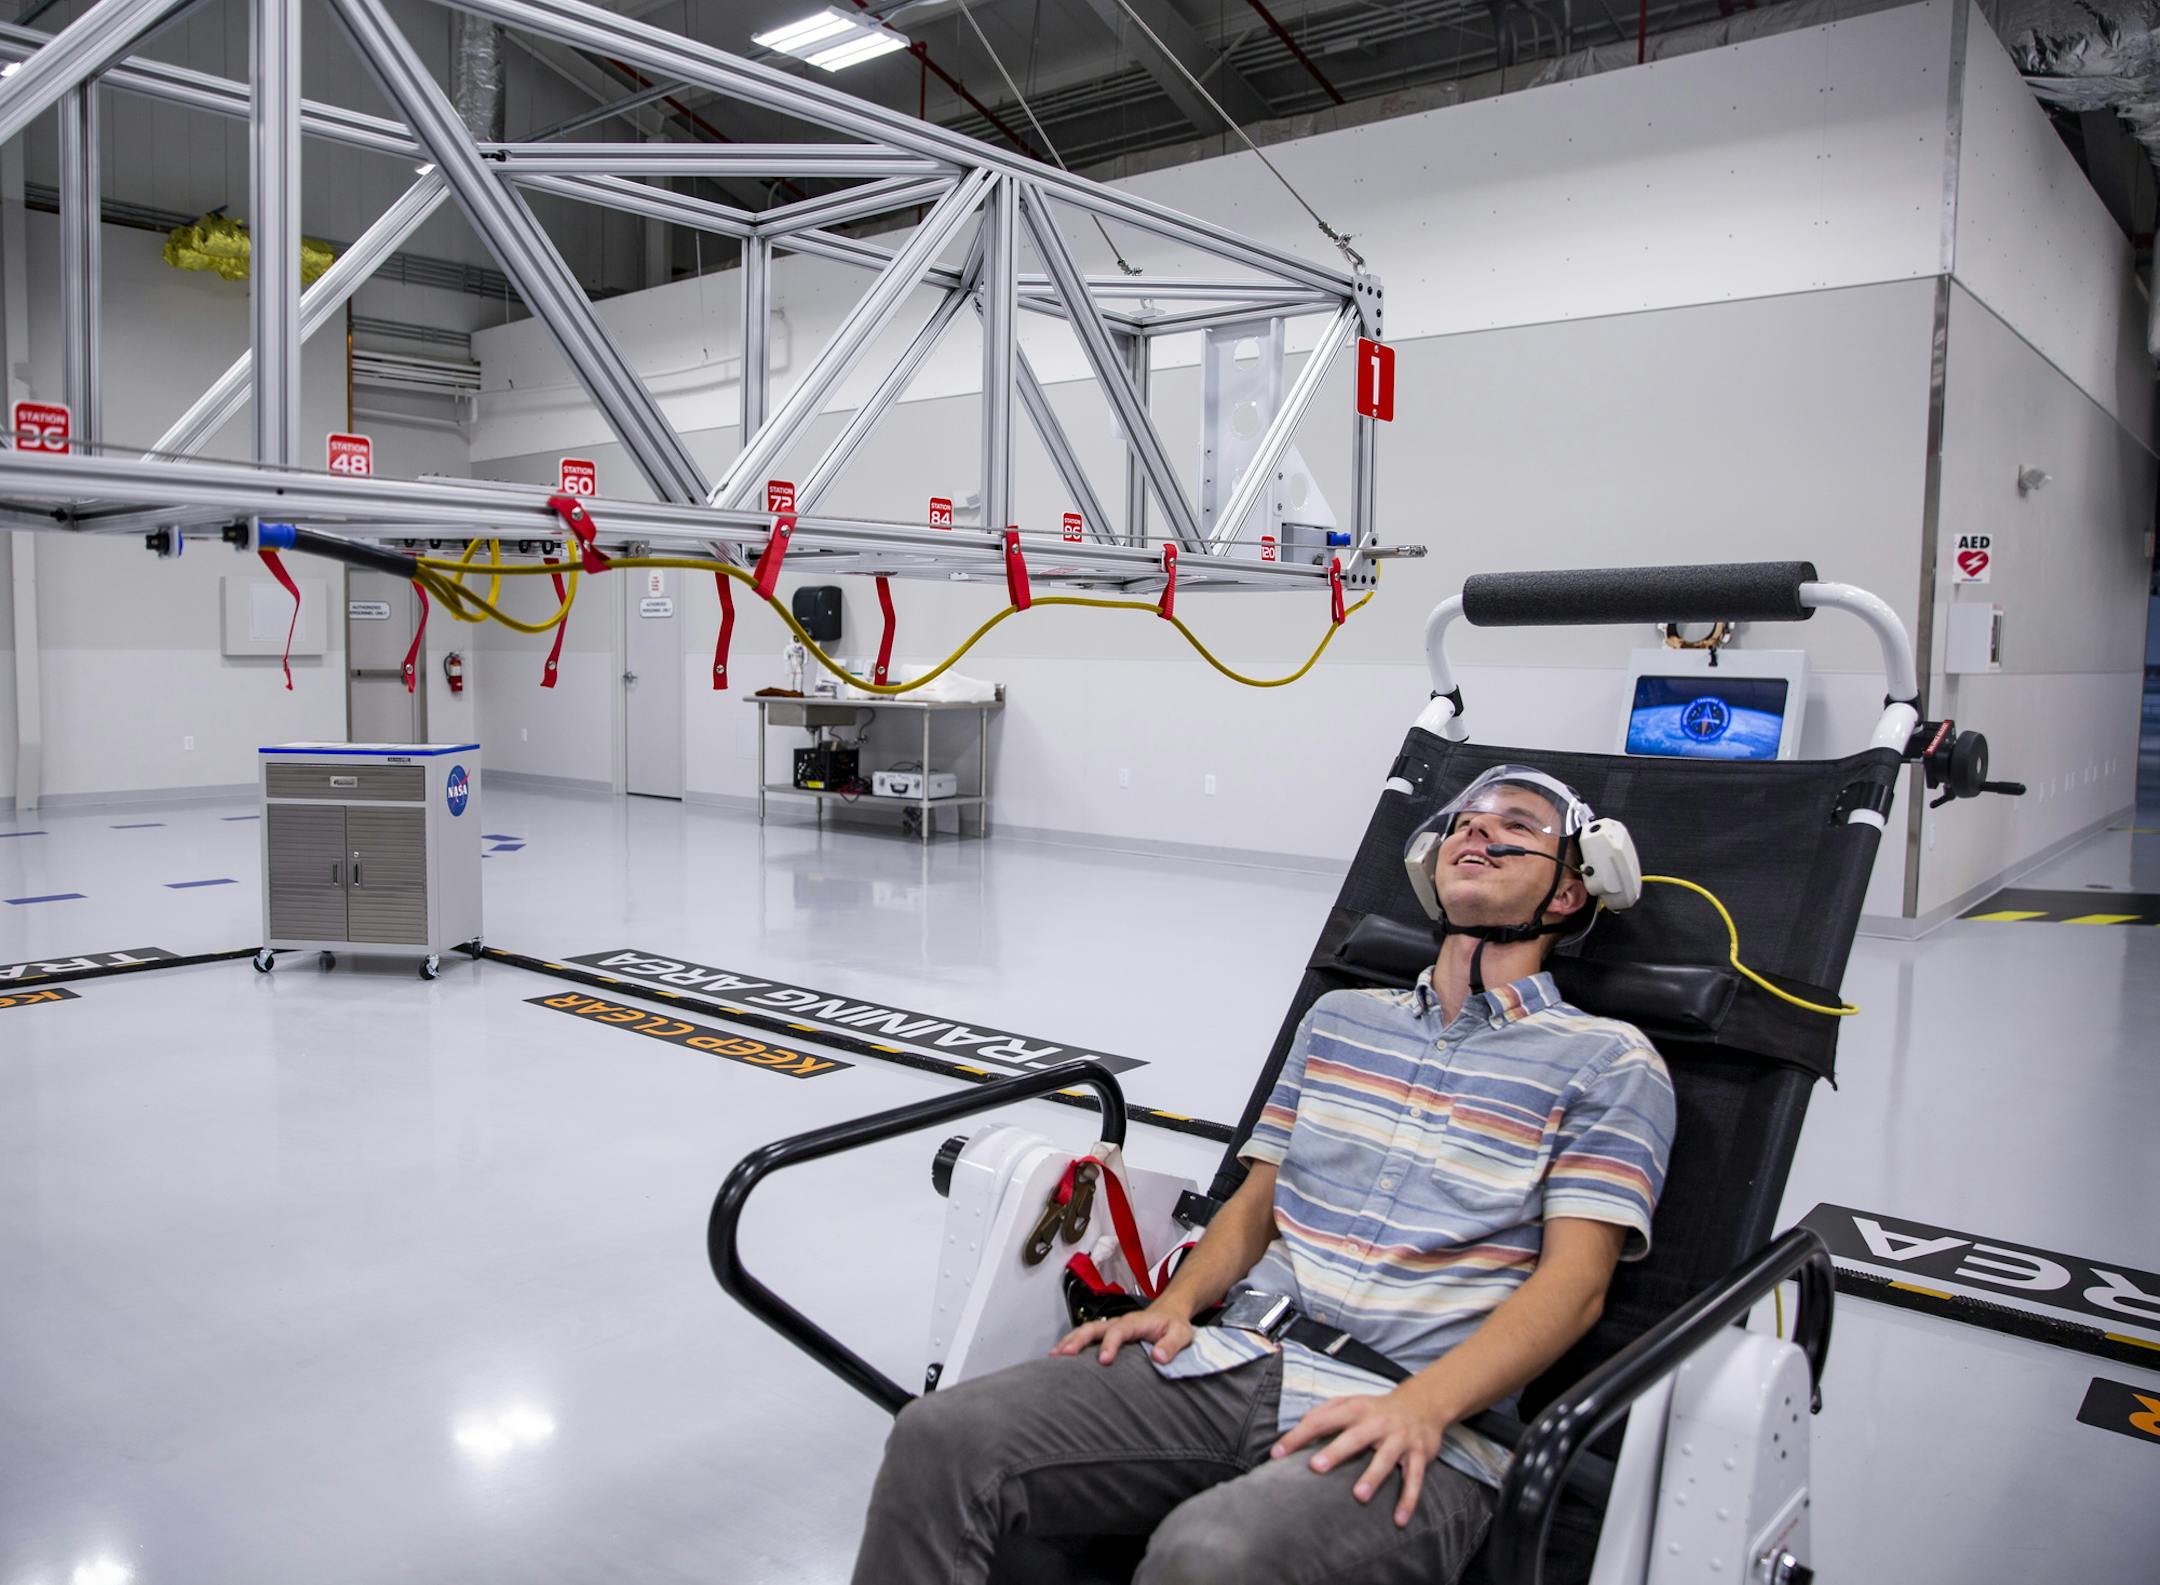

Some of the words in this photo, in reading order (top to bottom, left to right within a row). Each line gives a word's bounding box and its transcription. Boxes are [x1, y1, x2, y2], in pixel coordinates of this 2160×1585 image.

[1371, 356, 1380, 406] 1
[19, 411, 66, 425] STATION
[20, 424, 64, 450] 36
[331, 441, 368, 453] STATION
[331, 454, 367, 475] 48
[563, 466, 593, 475] STATION
[564, 476, 593, 496] 60
[769, 486, 794, 495] STATION
[770, 495, 793, 511] 72
[931, 502, 951, 510] STATION
[931, 511, 951, 527] 84
[1064, 525, 1081, 540] 96
[1958, 536, 1991, 549] AED
[1261, 546, 1276, 559] 120
[447, 783, 468, 798] NASA
[597, 952, 772, 992] AREA
[543, 993, 695, 1036] CLEAR
[685, 1035, 836, 1075] KEEP
